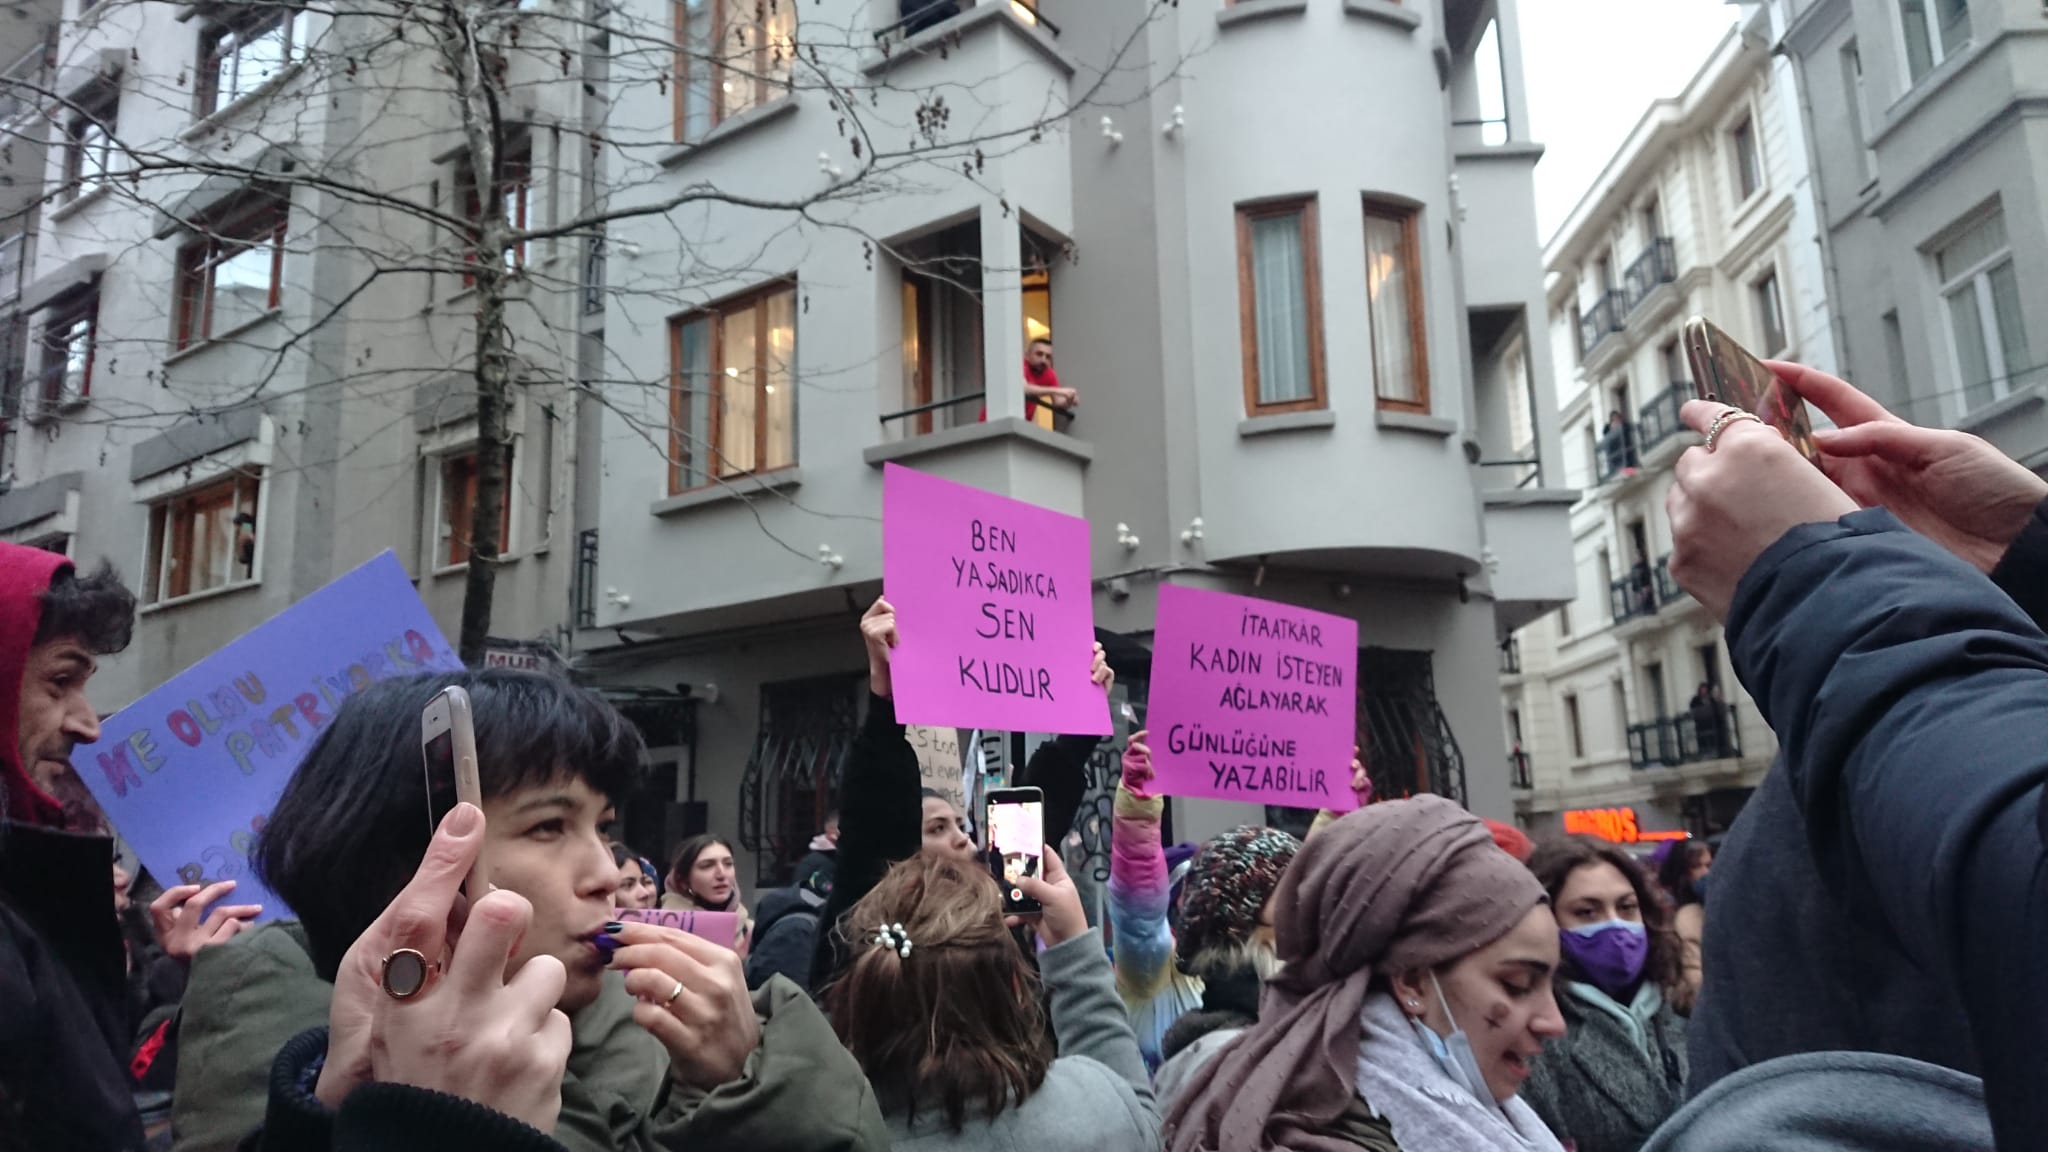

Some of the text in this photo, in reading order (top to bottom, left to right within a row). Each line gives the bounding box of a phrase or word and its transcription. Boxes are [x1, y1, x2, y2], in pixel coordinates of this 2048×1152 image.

[971, 519, 1016, 554] BEN
[951, 555, 1058, 601] YAŞADIKÇA
[976, 602, 1035, 642] SEN
[958, 655, 1054, 702] KUDUR
[1189, 642, 1343, 688] KADIN İSTEYEN
